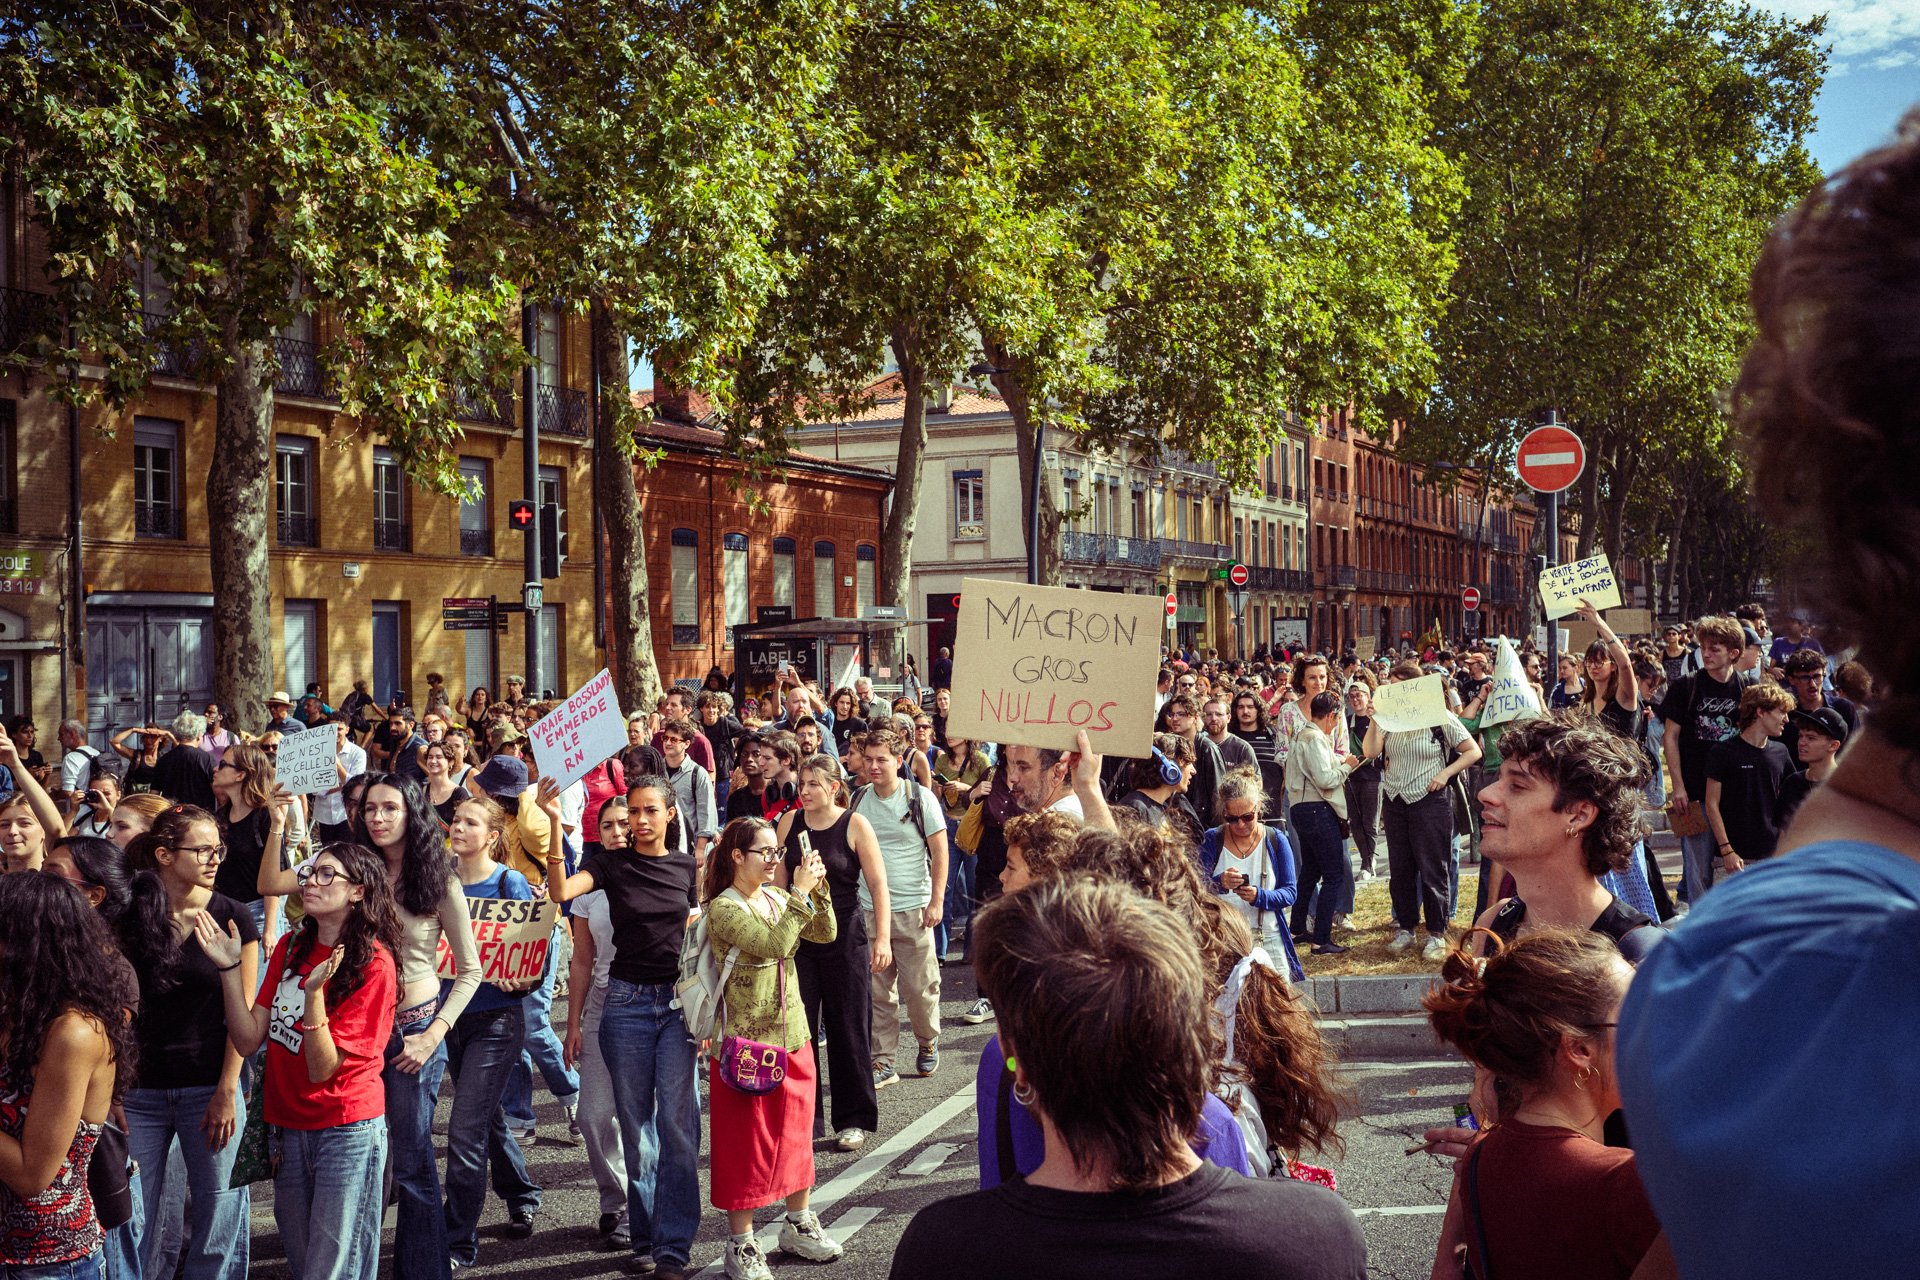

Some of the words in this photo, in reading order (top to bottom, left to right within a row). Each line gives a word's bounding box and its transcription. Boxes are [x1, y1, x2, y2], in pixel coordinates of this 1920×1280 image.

[1562, 577, 1575, 586] LA
[1580, 566, 1610, 580] BOUCHE
[1577, 559, 1599, 573] SORT
[16, 581, 33, 592] 14
[1571, 579, 1612, 596] ENFANTS
[986, 596, 1138, 646] MACRON
[1012, 655, 1093, 684] GROS
[568, 672, 610, 714] BOSSLADY
[1380, 688, 1395, 700] LE
[980, 687, 1120, 731] NULLOS
[545, 697, 607, 748] EMMERDE
[279, 738, 290, 750] MA
[293, 727, 326, 745] FRANCE
[563, 731, 580, 752] LE
[277, 751, 295, 764] MOI
[299, 741, 328, 758] N'EST
[564, 749, 585, 773] RN
[277, 765, 291, 777] PAS
[294, 757, 321, 773] CELLE
[324, 756, 336, 767] DU
[292, 775, 308, 789] RN
[479, 938, 548, 980] FACHO
